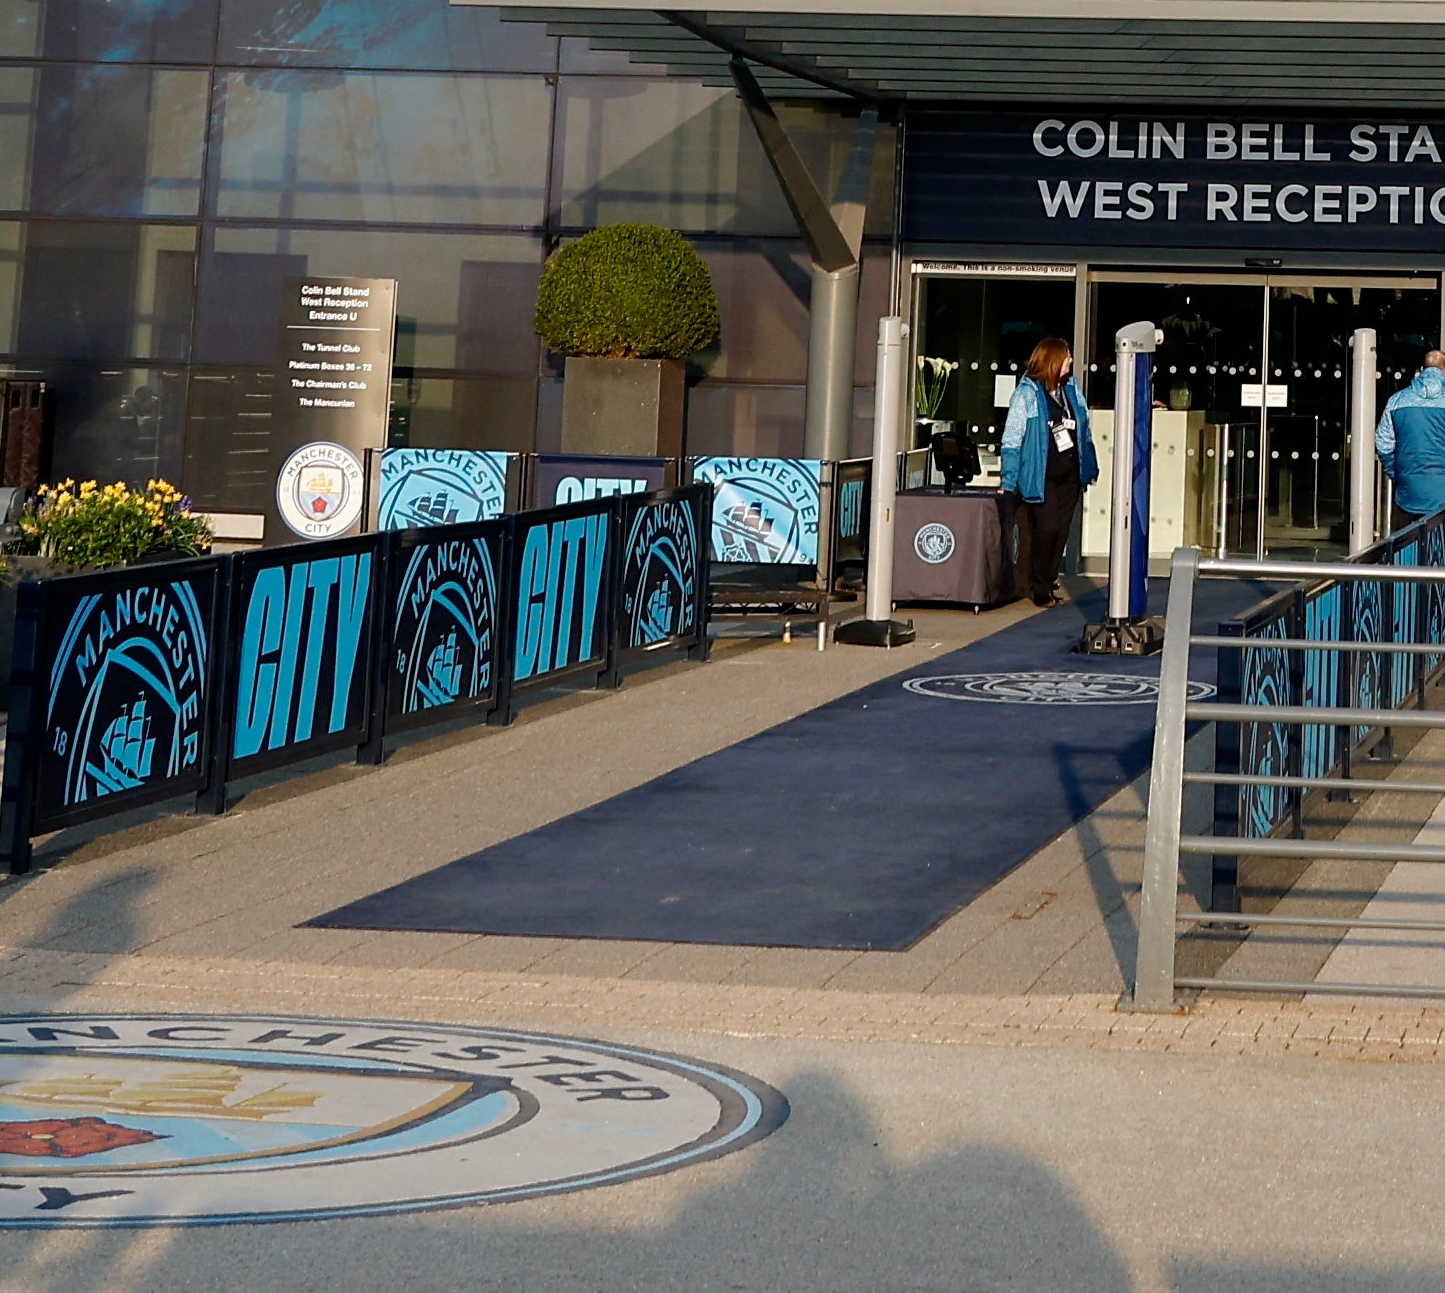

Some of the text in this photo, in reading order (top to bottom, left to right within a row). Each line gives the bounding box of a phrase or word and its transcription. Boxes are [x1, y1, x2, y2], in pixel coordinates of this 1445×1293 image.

[1033, 119, 1185, 159] COLIN
[1206, 122, 1332, 162] BELL
[1037, 179, 1188, 220] WEST
[301, 297, 369, 309] West Reception
[302, 286, 370, 297] Colin Bell Stand
[309, 311, 348, 321] Entrance
[289, 361, 344, 371] Platinum Boxes
[302, 343, 361, 353] The Tunnel Club
[291, 379, 367, 389] The Chairman's Club
[299, 398, 355, 408] The Mancunian
[287, 448, 358, 534] MANCHESTER CITY
[841, 480, 864, 539] CITY
[635, 503, 694, 630] MANCHESTER
[411, 541, 491, 691] MANCHESTER
[515, 513, 608, 681] CITY
[233, 552, 372, 760] CITY
[75, 587, 198, 769] MANCHESTER
[54, 726, 68, 757] 18
